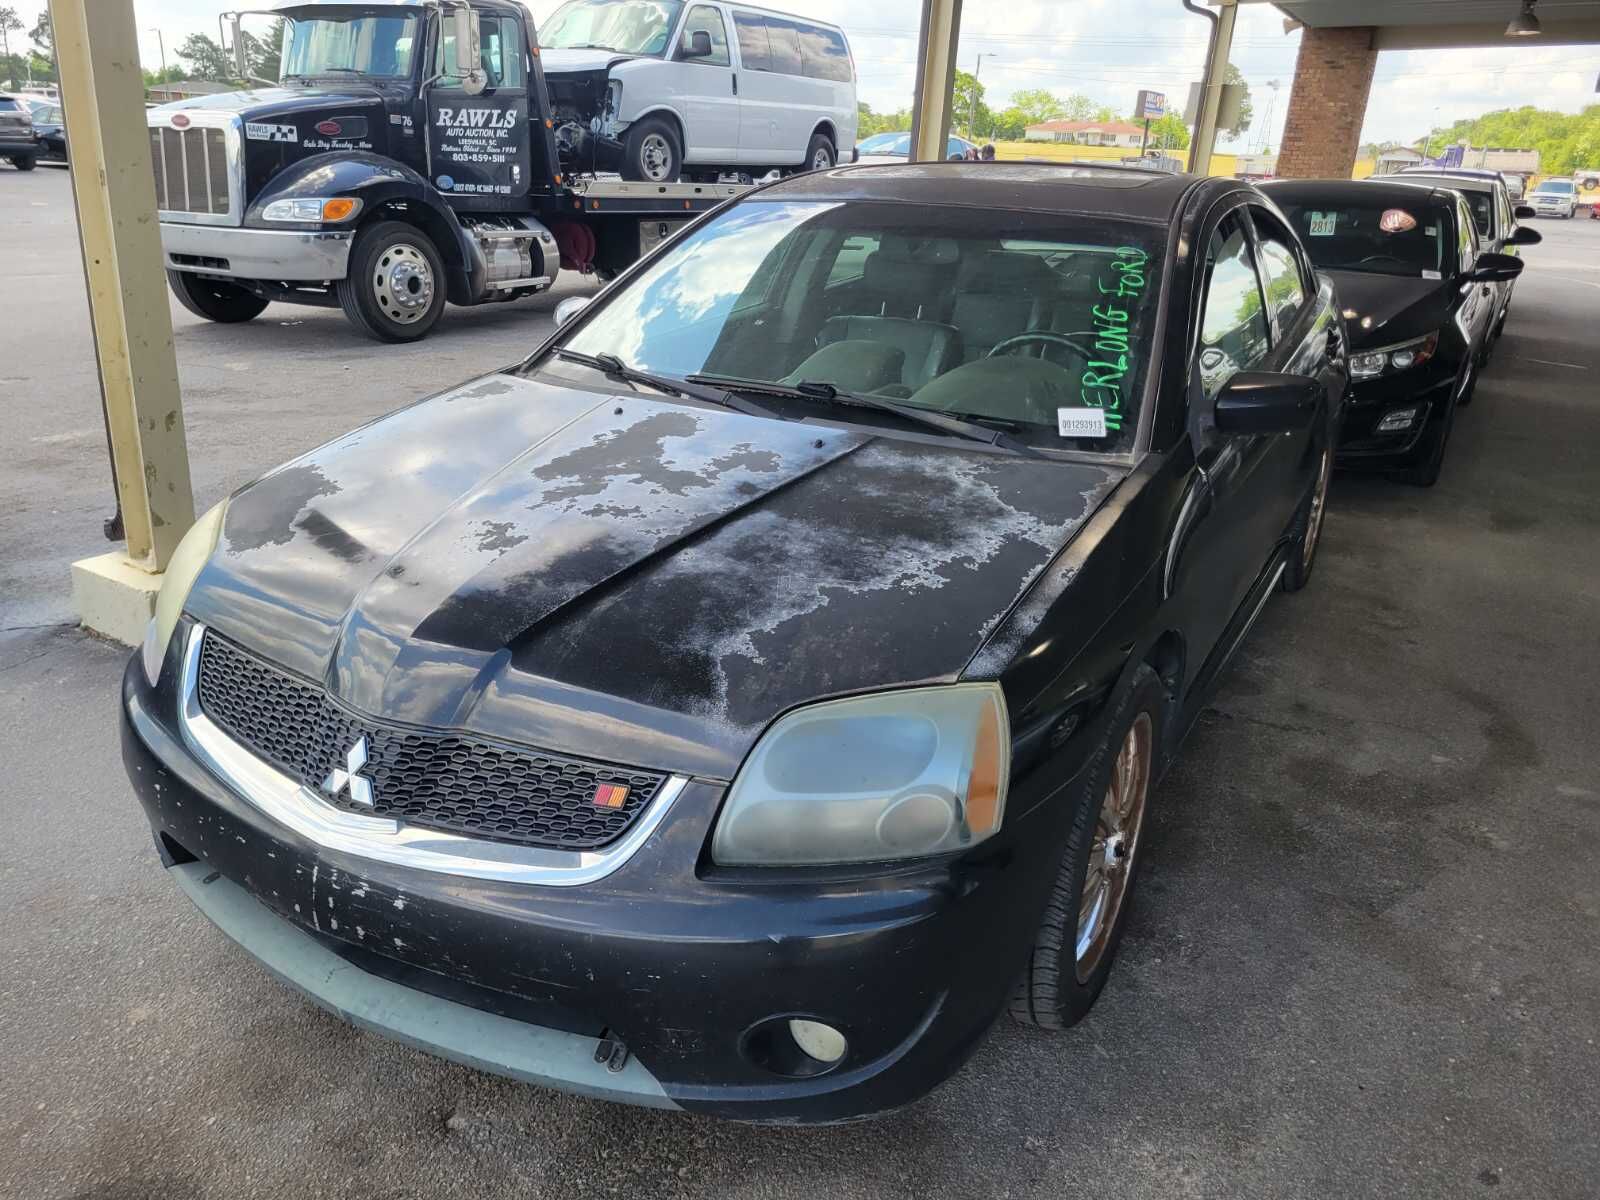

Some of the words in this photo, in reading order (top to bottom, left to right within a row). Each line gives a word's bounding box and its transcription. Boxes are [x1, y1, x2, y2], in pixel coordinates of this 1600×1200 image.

[402, 116, 413, 126] 76
[436, 108, 517, 128] RAWLS
[446, 128, 465, 137] AUTO
[465, 128, 495, 138] AUCTION,
[496, 129, 509, 137] INC.
[303, 139, 317, 148] Sale
[317, 139, 330, 150] Day
[331, 140, 353, 151] Tuesday
[1312, 221, 1334, 233] 2813
[1098, 246, 1148, 297] FORD
